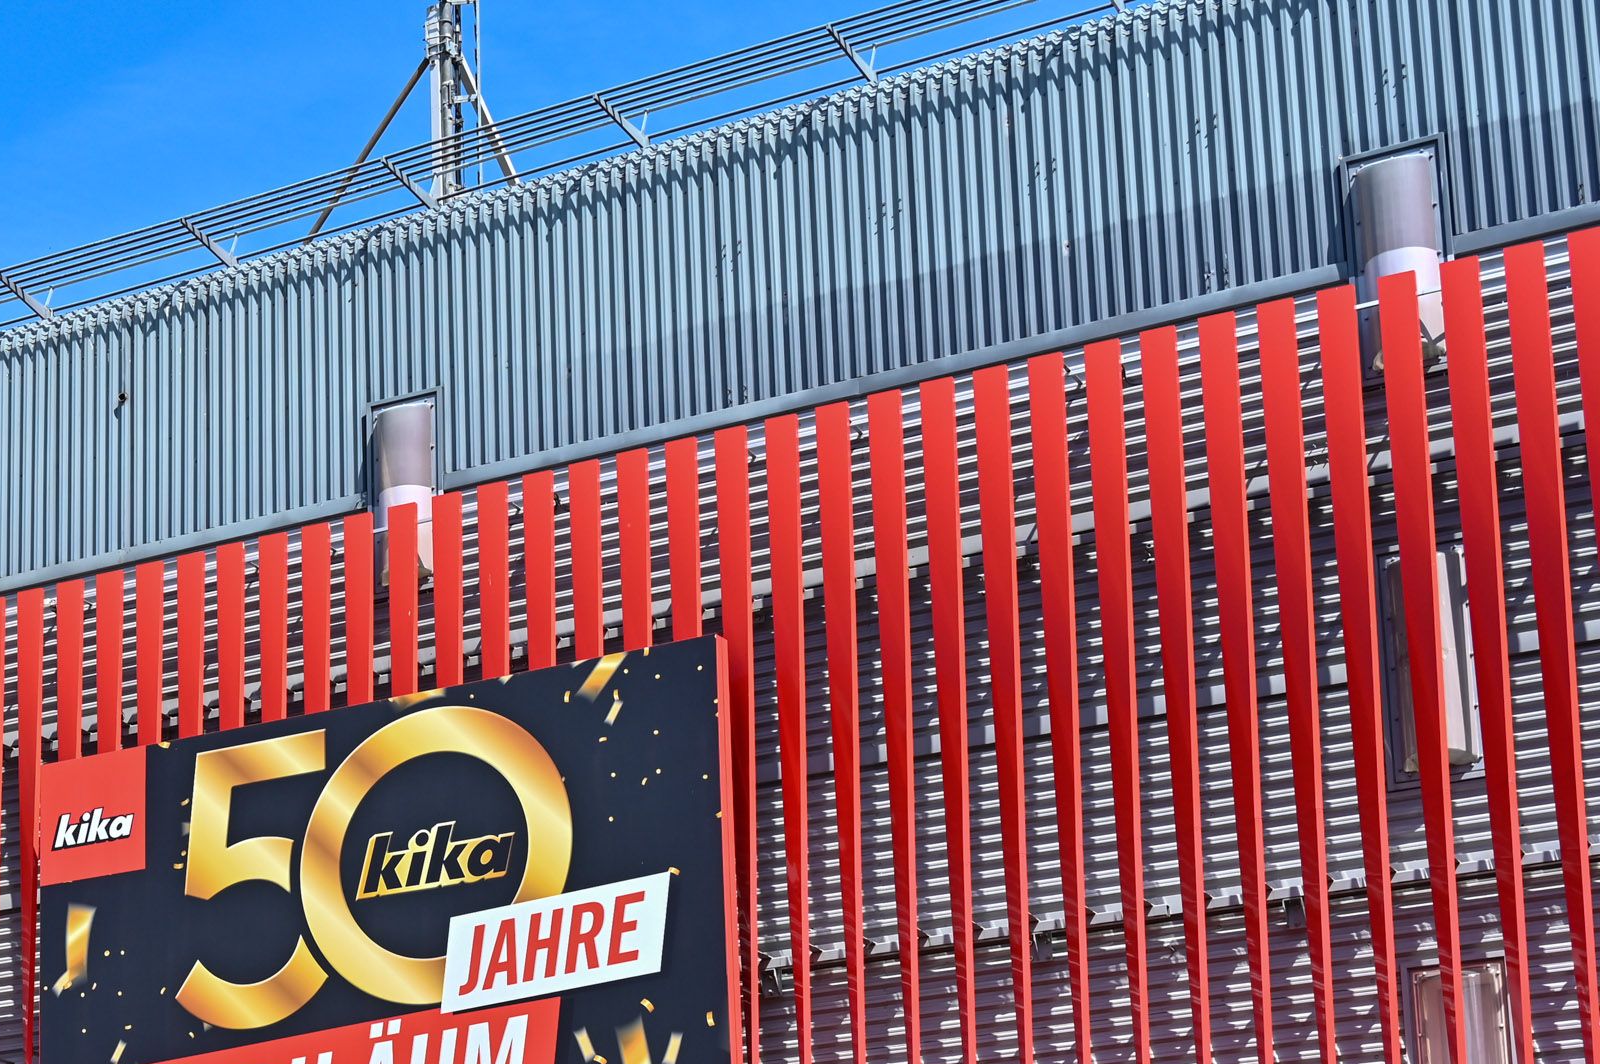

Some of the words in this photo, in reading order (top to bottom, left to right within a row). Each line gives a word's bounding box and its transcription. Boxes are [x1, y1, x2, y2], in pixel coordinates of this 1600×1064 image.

[52, 807, 134, 851] kika
[175, 705, 573, 1030] 50
[356, 820, 515, 901] kika
[458, 890, 645, 996] JAHRE
